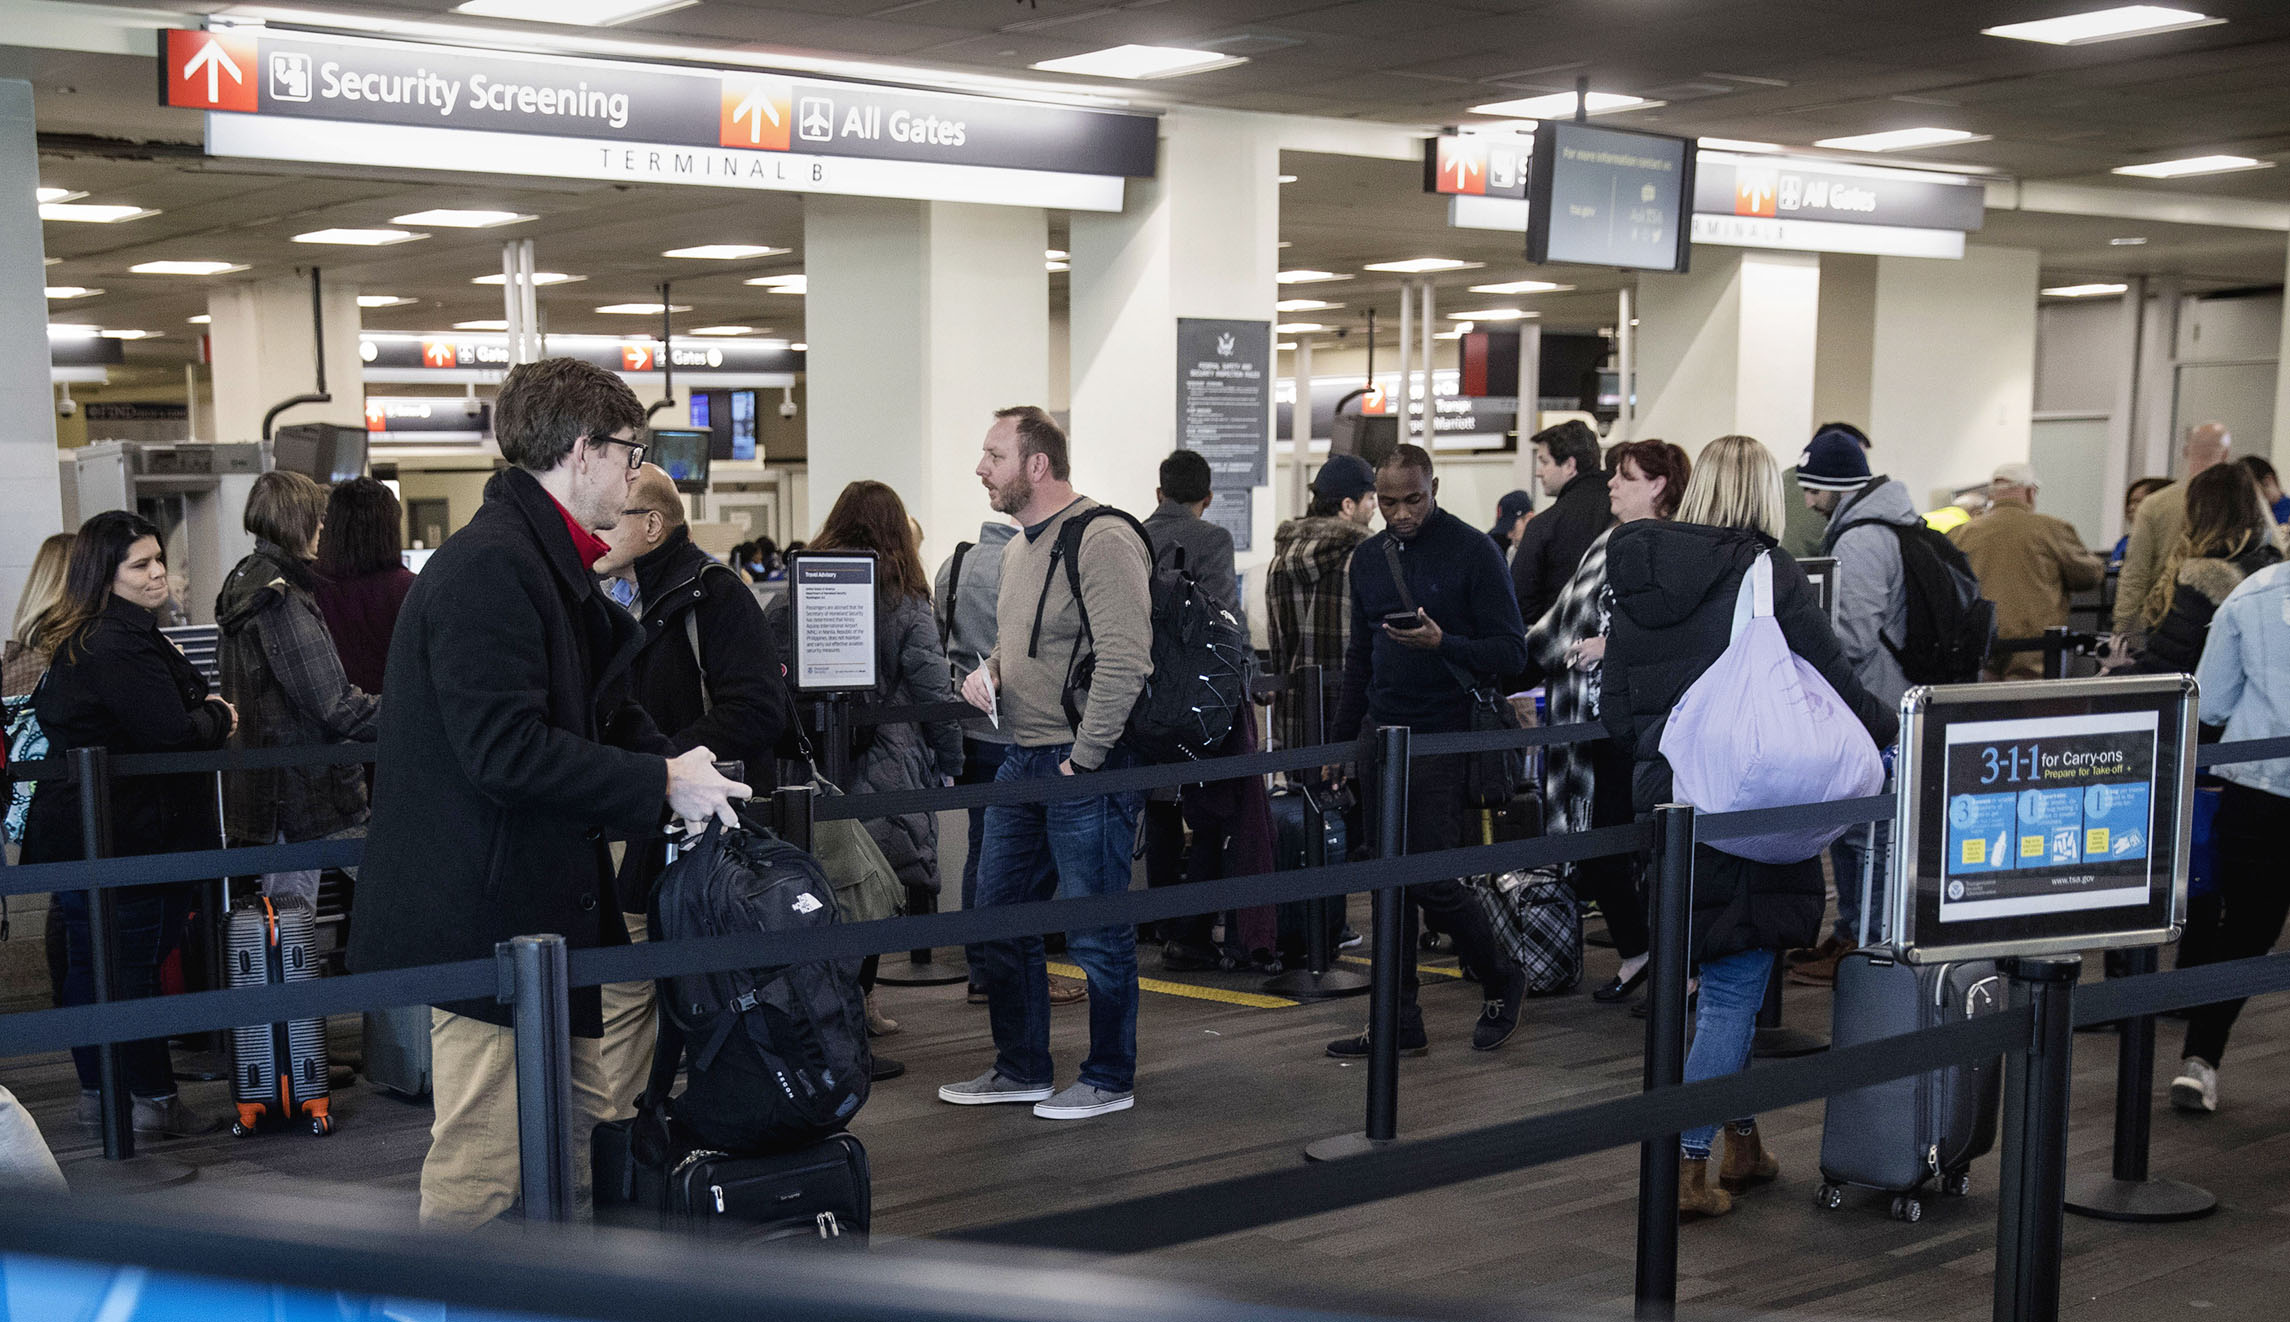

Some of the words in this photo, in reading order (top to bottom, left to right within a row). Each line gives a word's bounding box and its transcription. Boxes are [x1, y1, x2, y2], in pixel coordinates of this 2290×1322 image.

[321, 62, 460, 115] Security
[469, 75, 629, 128] Screening
[841, 112, 881, 140] All
[888, 113, 966, 147] Gates
[602, 148, 786, 181] TERMINAL
[812, 163, 823, 183] B
[1802, 181, 1829, 208] All
[1829, 183, 1877, 212] Gates
[671, 348, 708, 365] Gates
[1980, 744, 2041, 784] 3-1-1
[2041, 752, 2060, 767] for
[2062, 750, 2123, 768] Carry-ons
[2044, 768, 2076, 780] Prepare
[2079, 767, 2090, 776] for
[1958, 800, 1968, 822] 3
[2051, 875, 2095, 886] www.tsa.gov
